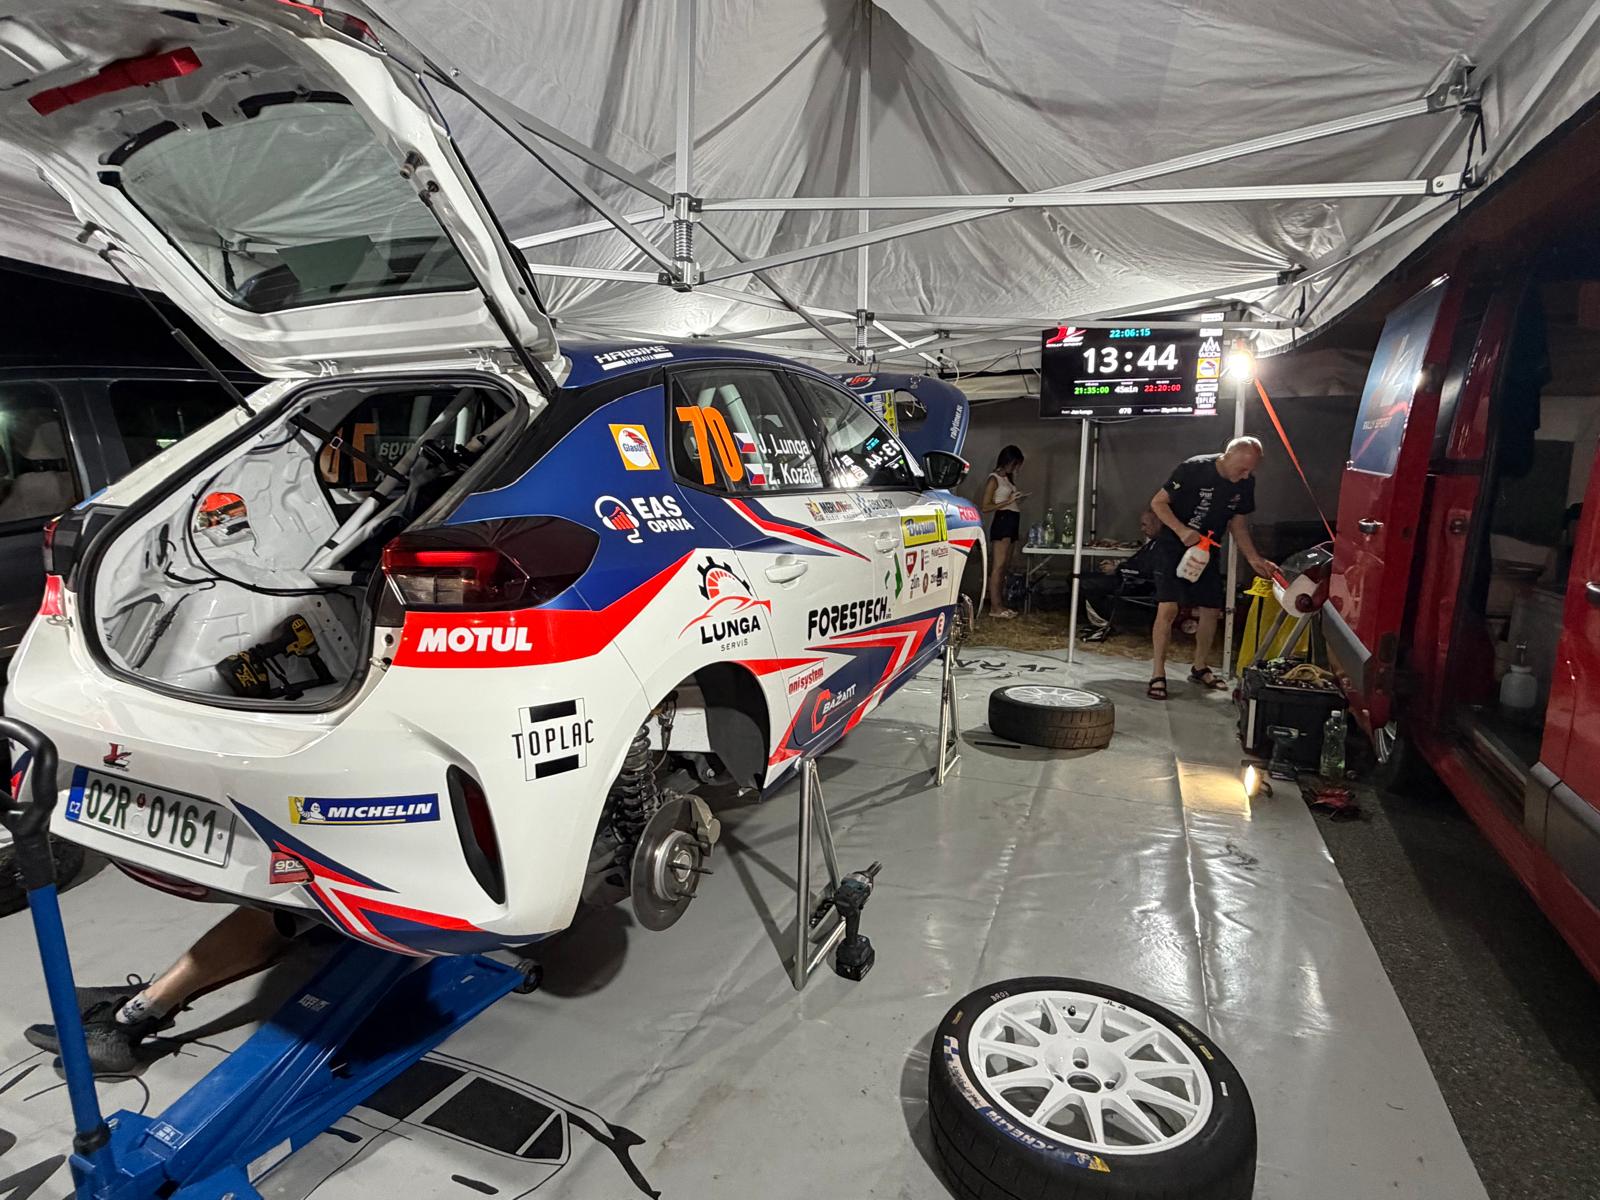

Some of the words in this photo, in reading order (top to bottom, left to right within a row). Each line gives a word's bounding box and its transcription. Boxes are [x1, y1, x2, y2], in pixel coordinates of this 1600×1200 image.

[1109, 328, 1151, 339] 22:06:15
[1083, 344, 1179, 374] 13:44
[1074, 386, 1110, 395] 21:35:00
[1144, 384, 1181, 392] 22:20:00
[676, 405, 744, 485] 70
[758, 433, 772, 454] J.
[769, 434, 811, 460] Lunga
[764, 462, 781, 485] Z.
[779, 462, 818, 485] Kozák
[631, 494, 684, 519] EAS
[647, 517, 695, 533] OPAVA
[700, 615, 761, 644] LUNGA
[807, 596, 888, 641] FORESTECH
[416, 626, 533, 653] MOTUL
[721, 638, 748, 652] SERVIS
[511, 718, 595, 760] TOPLAC
[68, 800, 81, 815] CZ
[85, 779, 132, 830] 02R
[147, 795, 217, 854] 0161
[327, 802, 432, 818] MICHELIN
